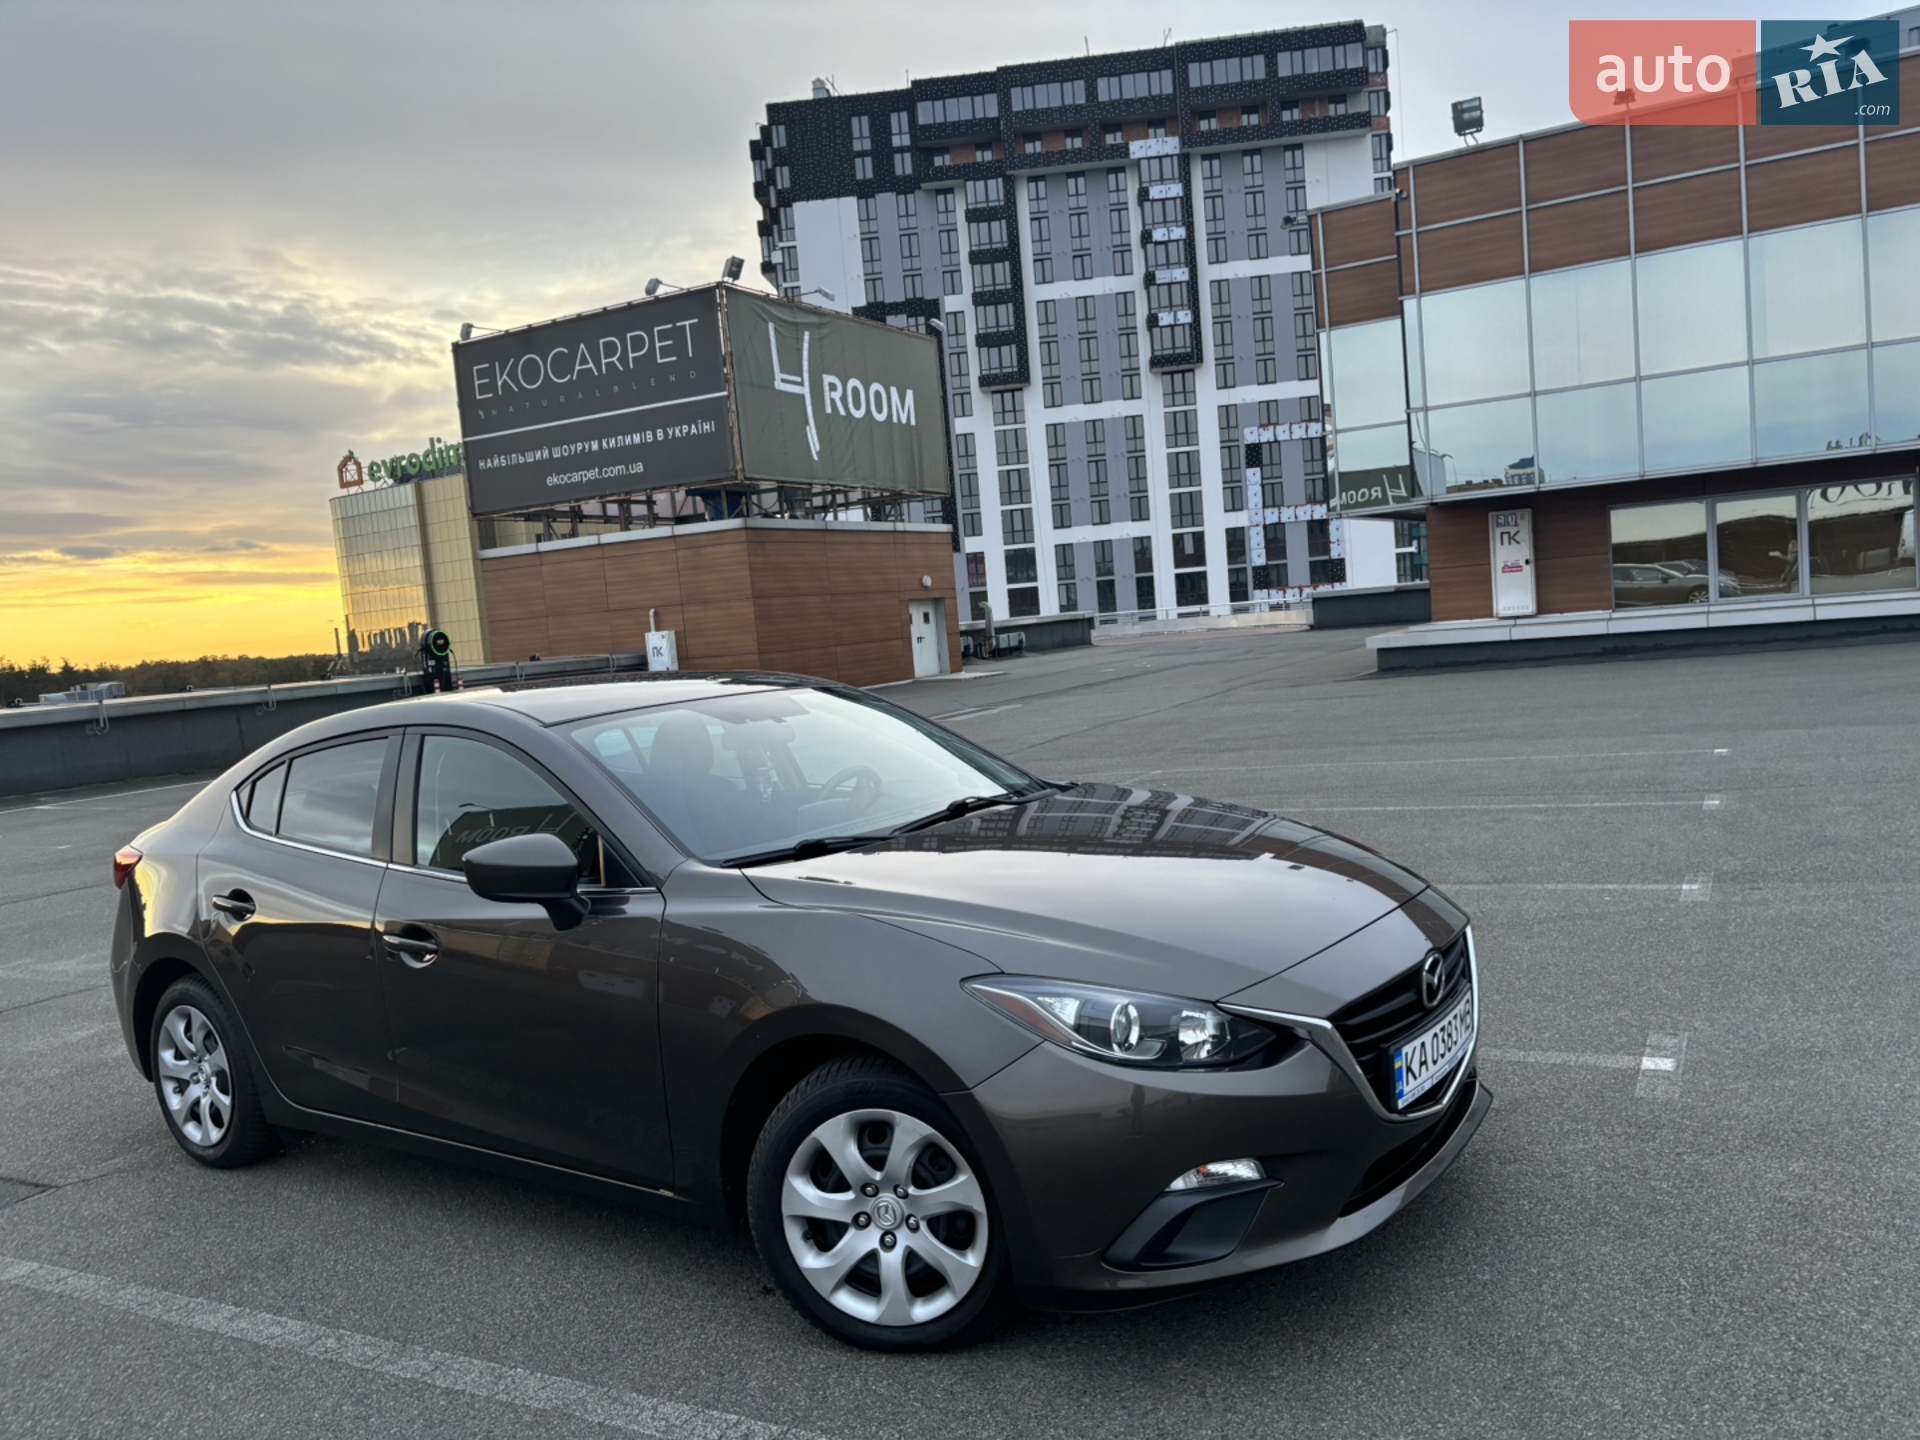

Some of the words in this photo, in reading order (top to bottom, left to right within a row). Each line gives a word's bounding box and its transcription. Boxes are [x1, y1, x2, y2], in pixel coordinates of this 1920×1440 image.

[473, 318, 699, 400] EKOCARPET
[822, 373, 917, 426] ROOM
[478, 446, 549, 470] НАЙБІЛЬШИЙ
[551, 440, 600, 459] ШОУРУМ
[601, 430, 654, 450] КИЛИМІВ
[656, 429, 664, 441] В
[667, 419, 716, 440] УКРАЇНІ
[546, 460, 644, 486] ekocarpet.com.ua
[1500, 530, 1521, 546] ПК
[652, 646, 664, 658] ПК
